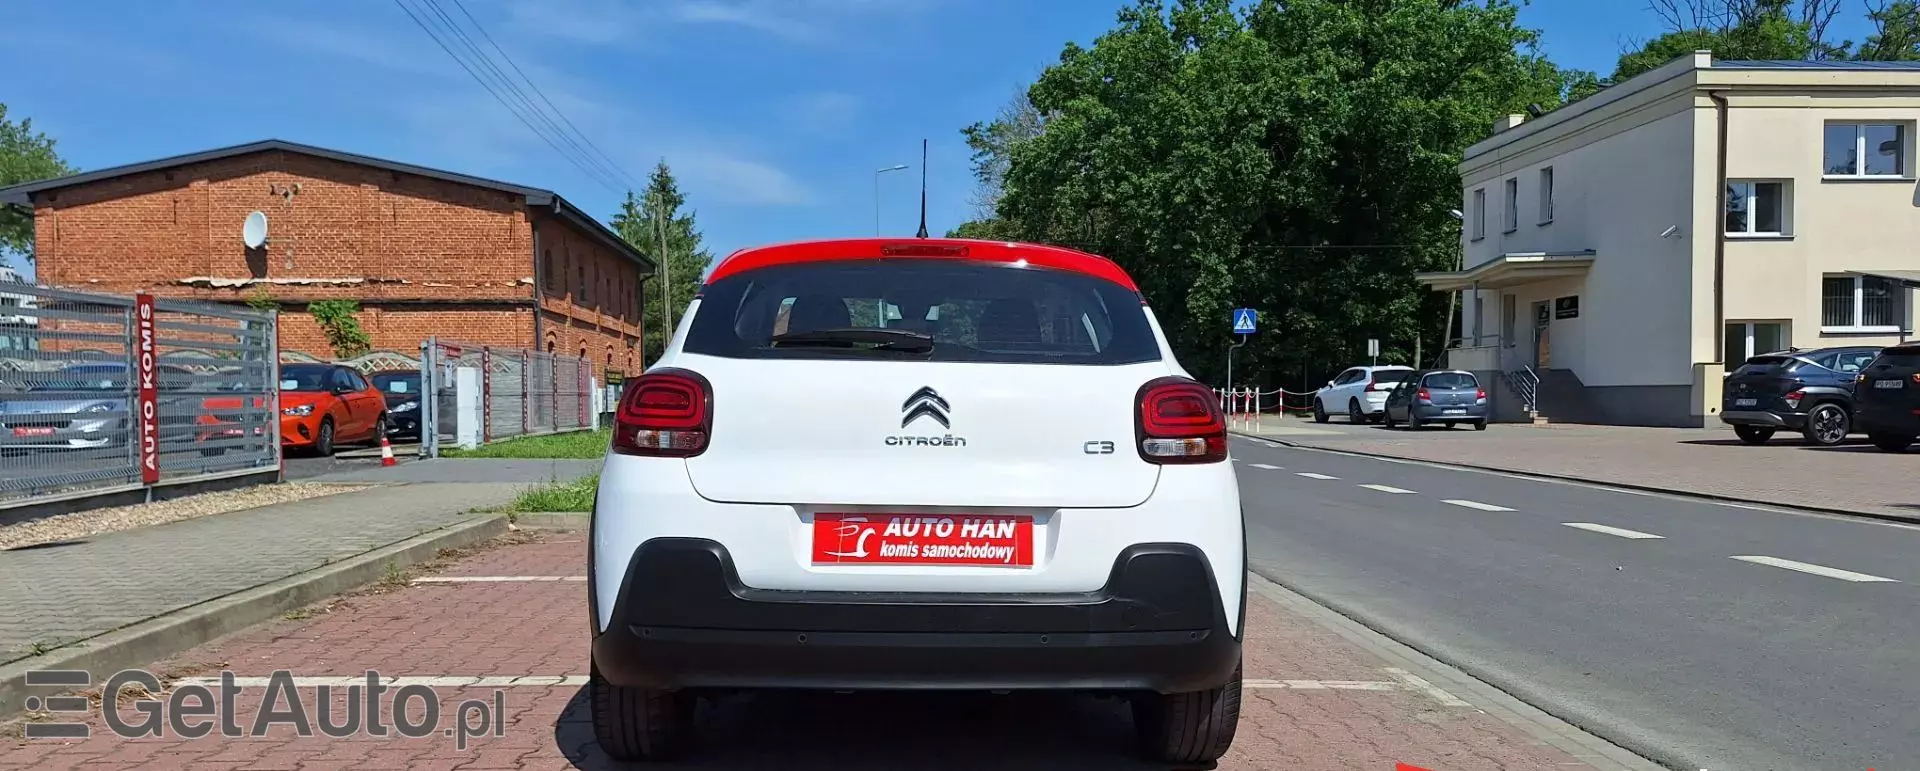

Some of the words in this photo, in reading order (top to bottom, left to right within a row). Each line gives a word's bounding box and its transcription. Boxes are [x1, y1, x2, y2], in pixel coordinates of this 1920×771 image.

[140, 303, 153, 389] KOMIS
[143, 400, 155, 470] AUTO
[1083, 440, 1116, 455] C3
[882, 517, 957, 539] AUTO
[960, 519, 1016, 540] HAN
[880, 539, 920, 558] komis
[922, 541, 1016, 564] samochodowy
